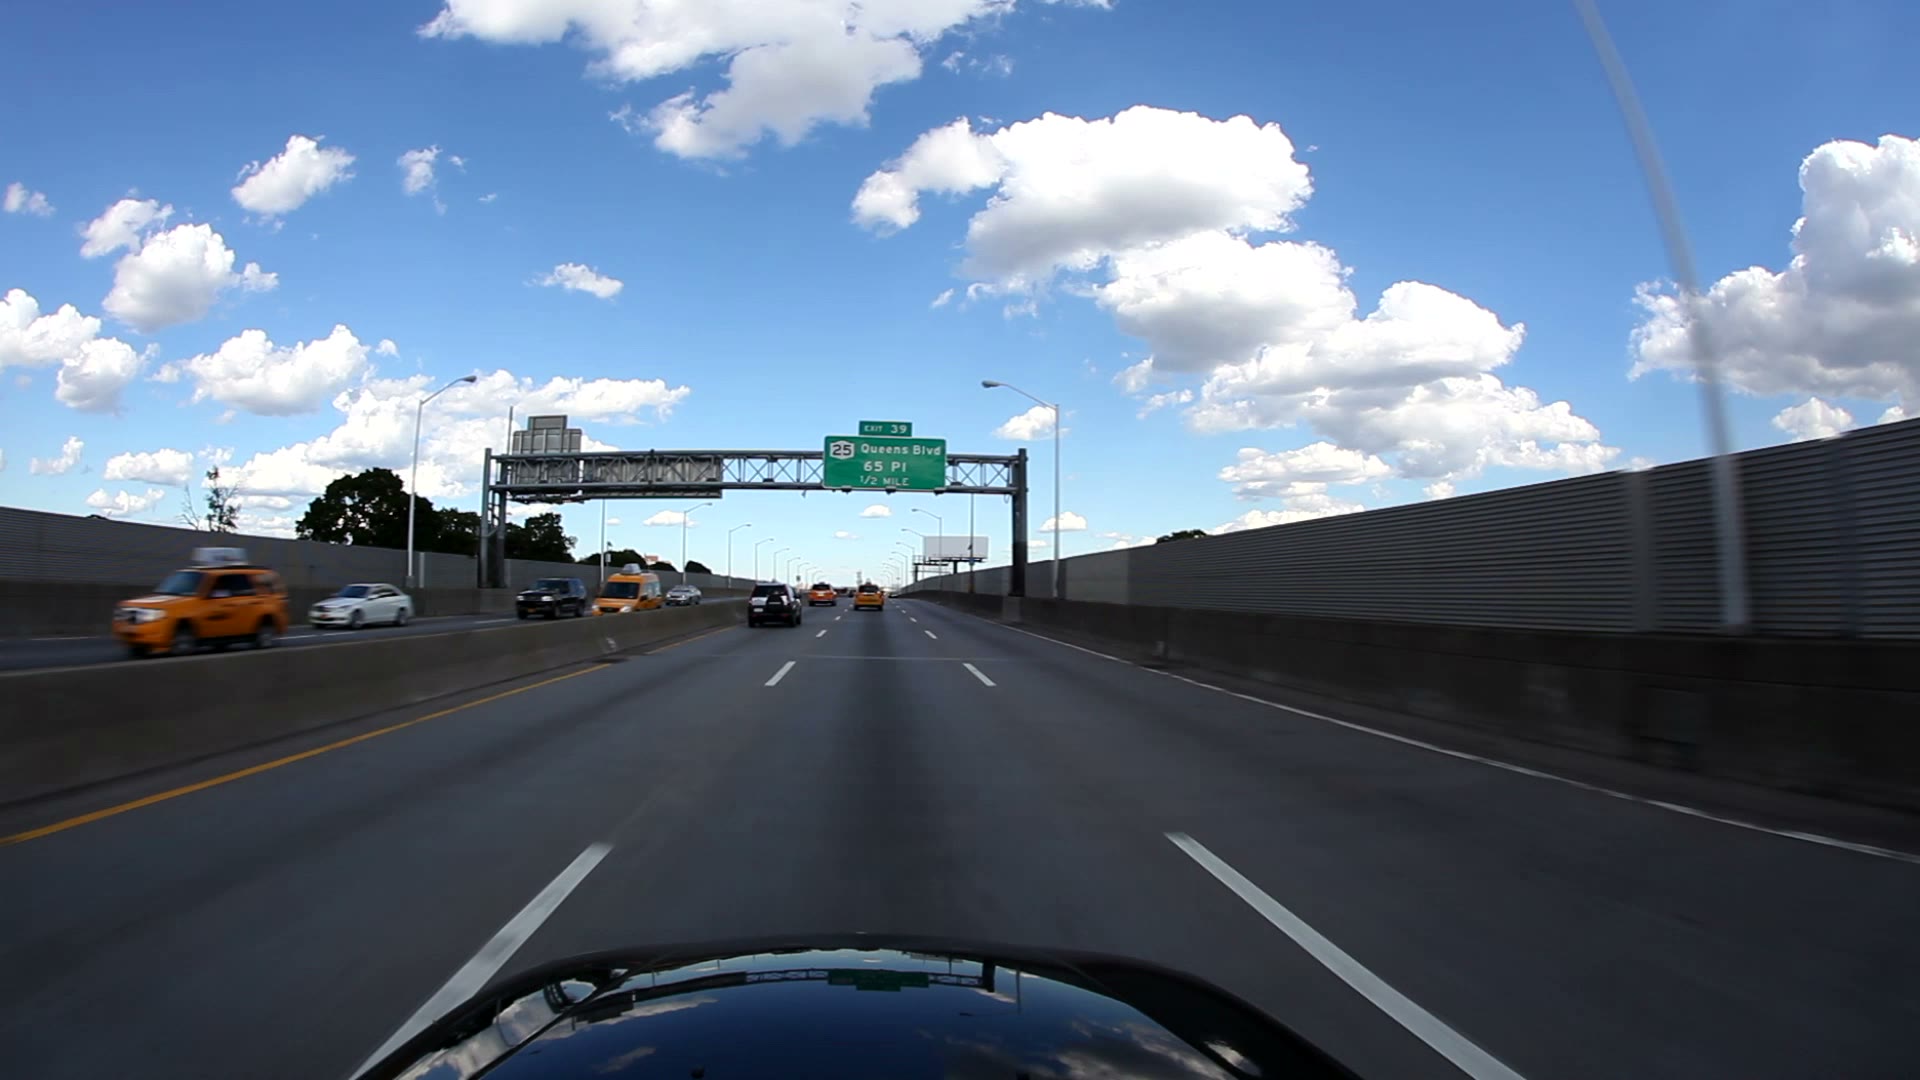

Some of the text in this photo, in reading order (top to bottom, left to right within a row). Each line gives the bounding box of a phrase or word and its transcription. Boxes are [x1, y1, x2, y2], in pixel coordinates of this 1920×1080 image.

[890, 424, 907, 434] 39
[832, 444, 852, 456] 25
[861, 443, 942, 455] Queens Blvd
[863, 461, 883, 472] 65
[860, 475, 909, 486] 1/2 MILE
